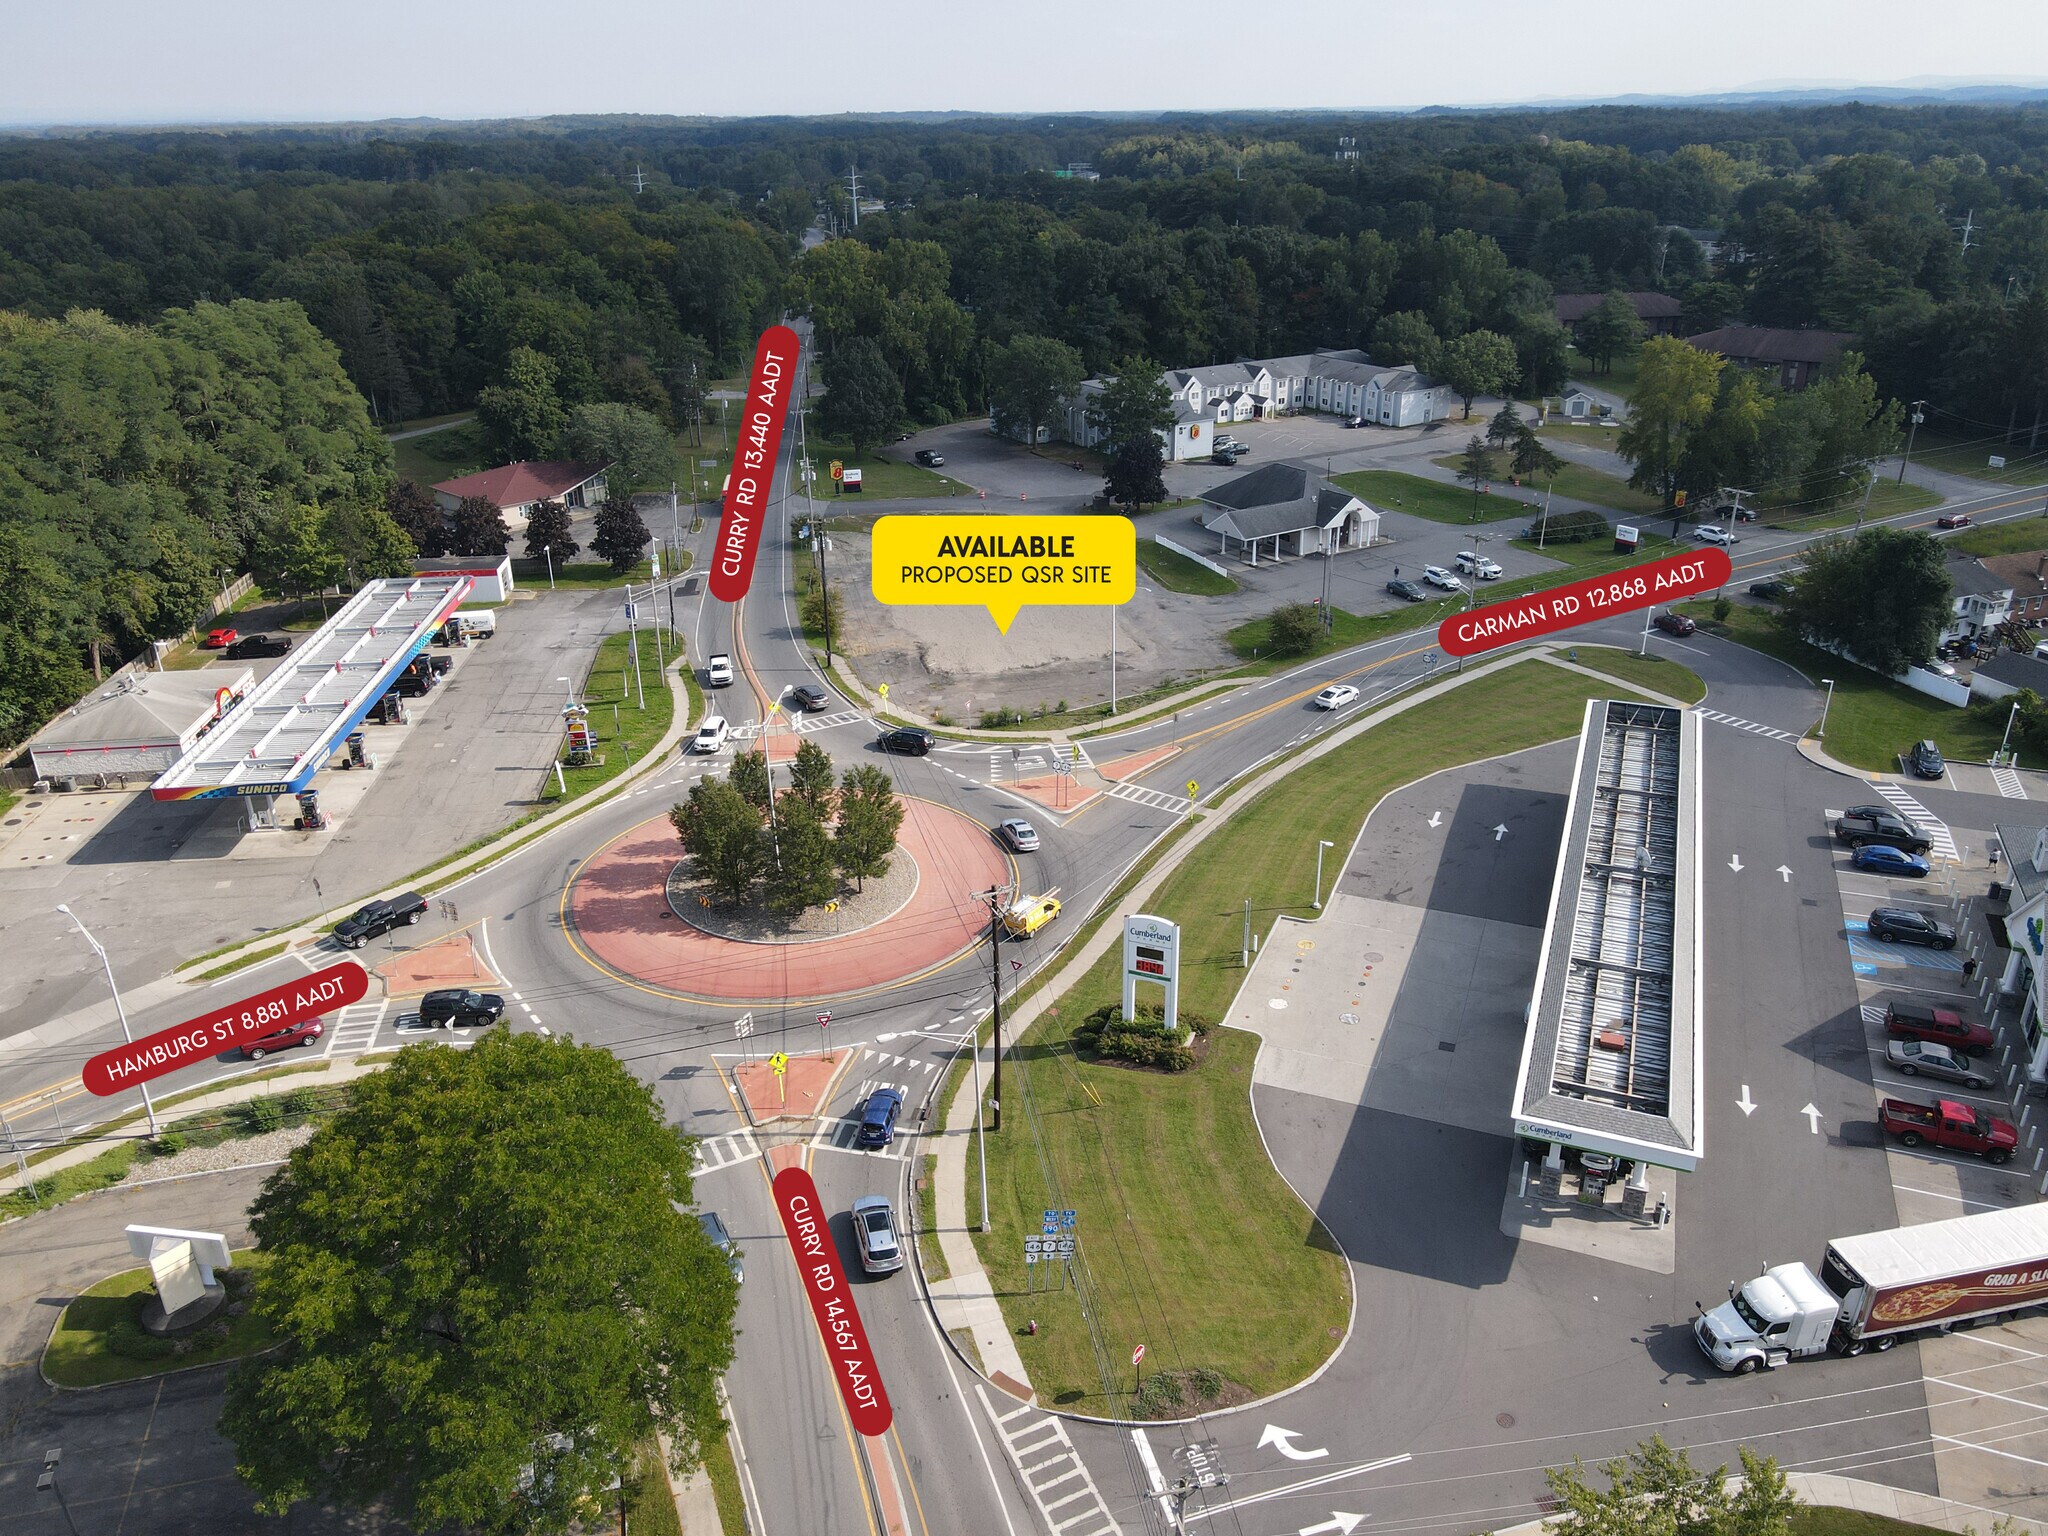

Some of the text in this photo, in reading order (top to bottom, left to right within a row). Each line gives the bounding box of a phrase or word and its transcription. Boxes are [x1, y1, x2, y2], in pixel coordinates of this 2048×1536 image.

[237, 784, 287, 795] SUNOCO
[1130, 928, 1171, 941] Cumberland
[1529, 1124, 1573, 1140] Cumberland
[1984, 1274, 2017, 1286] GRAB
[2016, 1272, 2028, 1285] A
[1187, 1450, 1216, 1486] STOP
